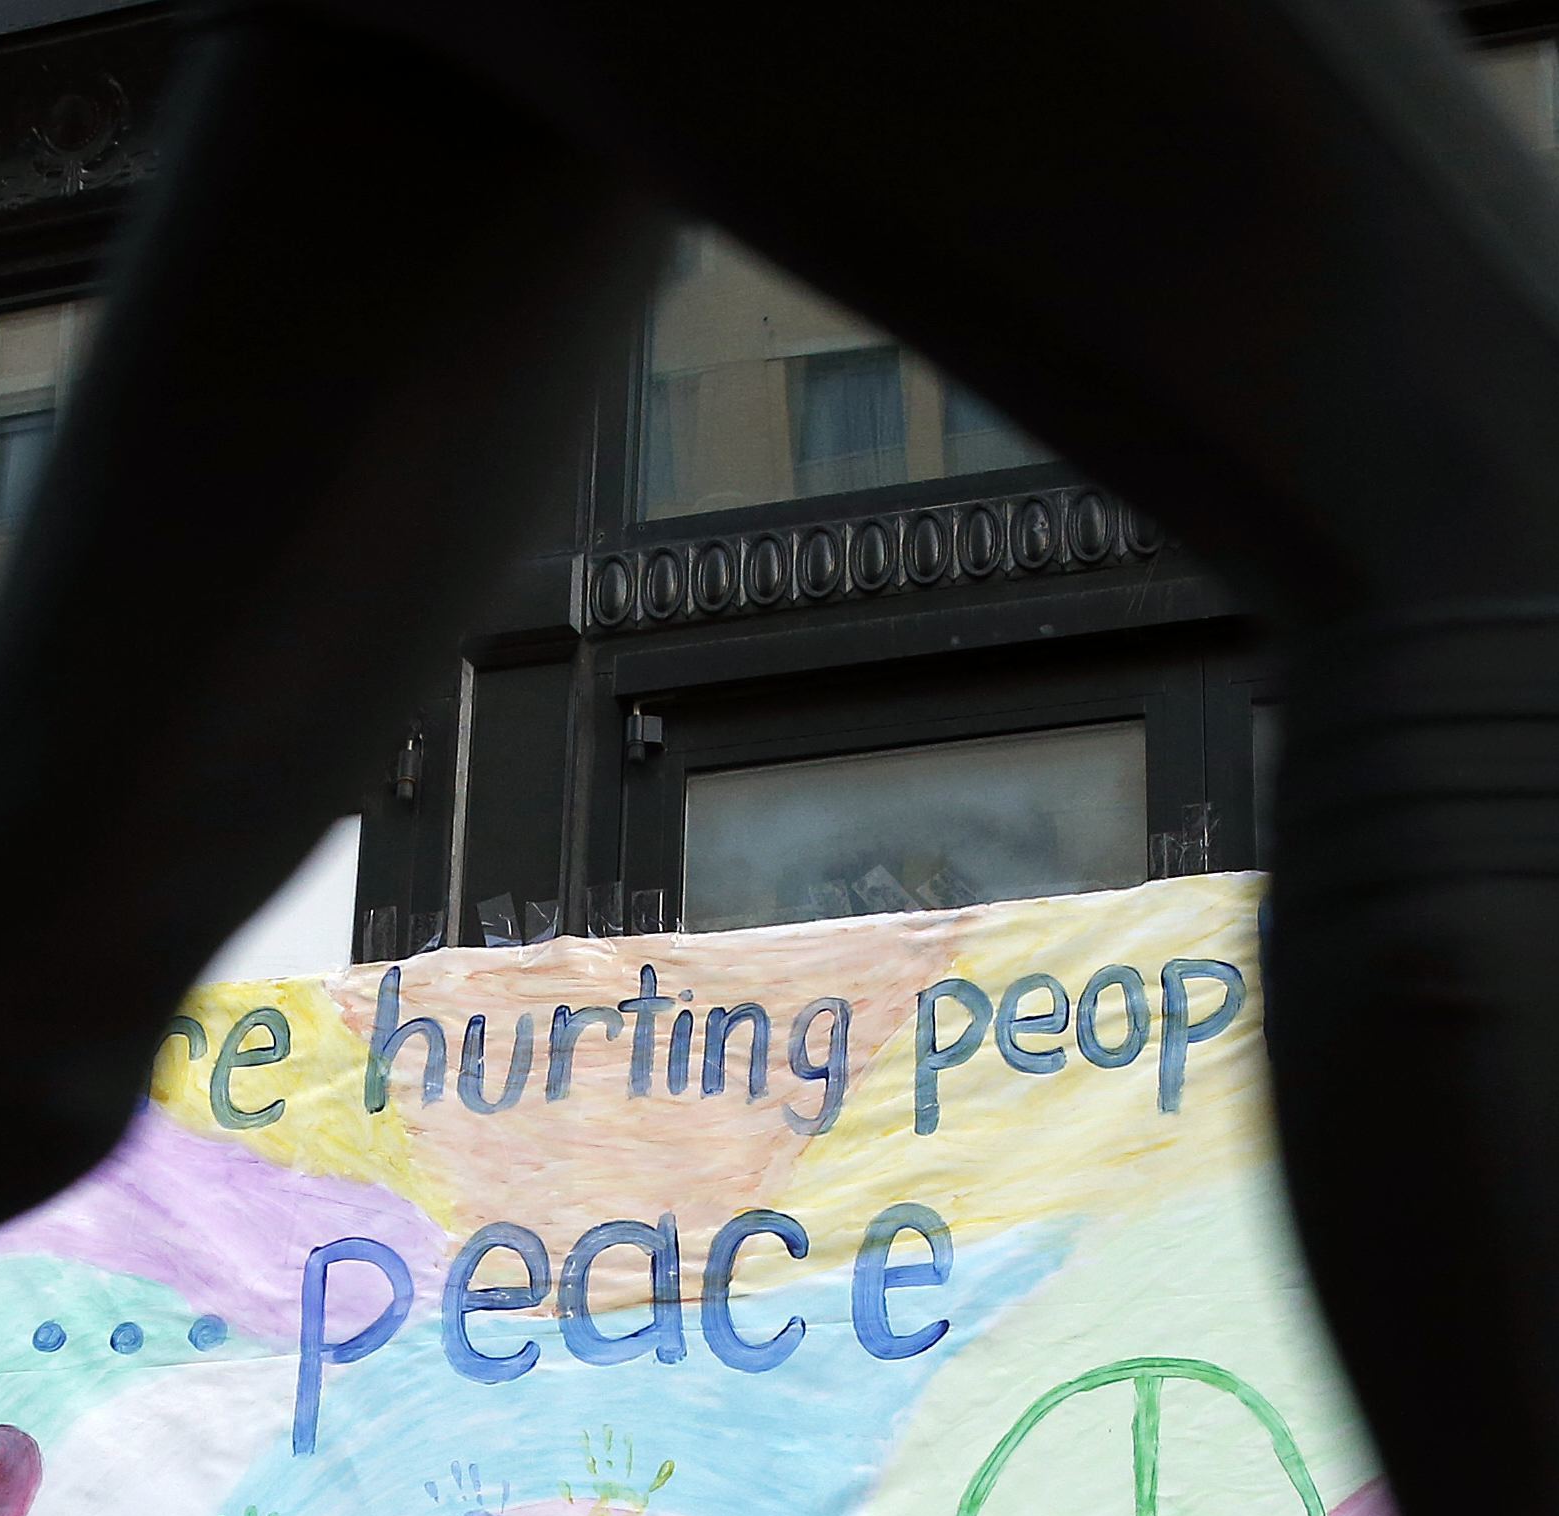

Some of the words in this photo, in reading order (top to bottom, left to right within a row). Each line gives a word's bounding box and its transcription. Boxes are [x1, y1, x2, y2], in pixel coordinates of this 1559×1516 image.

[153, 1006, 290, 1130] re
[363, 964, 851, 1136] hurting
[913, 958, 1247, 1136] peop
[291, 1201, 954, 1457] peace
